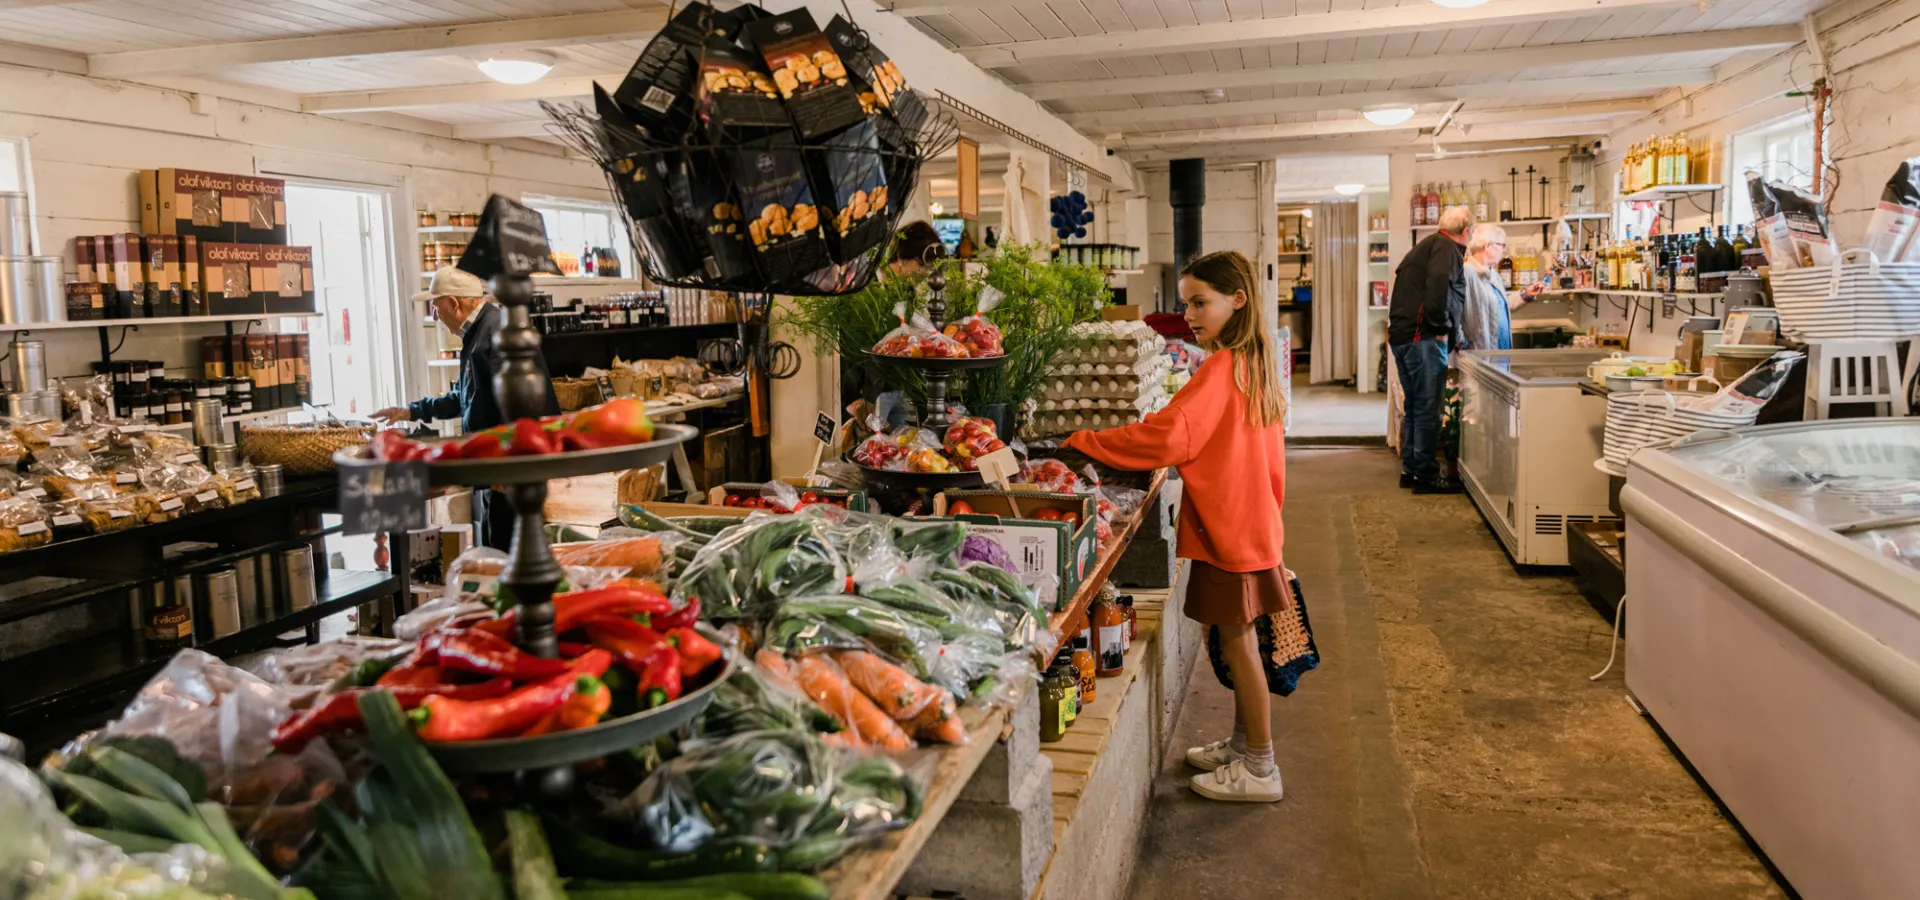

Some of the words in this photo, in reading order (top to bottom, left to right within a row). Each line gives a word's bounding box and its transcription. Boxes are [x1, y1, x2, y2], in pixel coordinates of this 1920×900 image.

[178, 173, 199, 187] olaf
[200, 176, 232, 190] viktors
[236, 180, 254, 192] olaf
[255, 181, 283, 195] viktors
[208, 247, 228, 260] olaf
[229, 247, 259, 261] viktors
[265, 249, 283, 261] olaf
[284, 249, 311, 262] viktors
